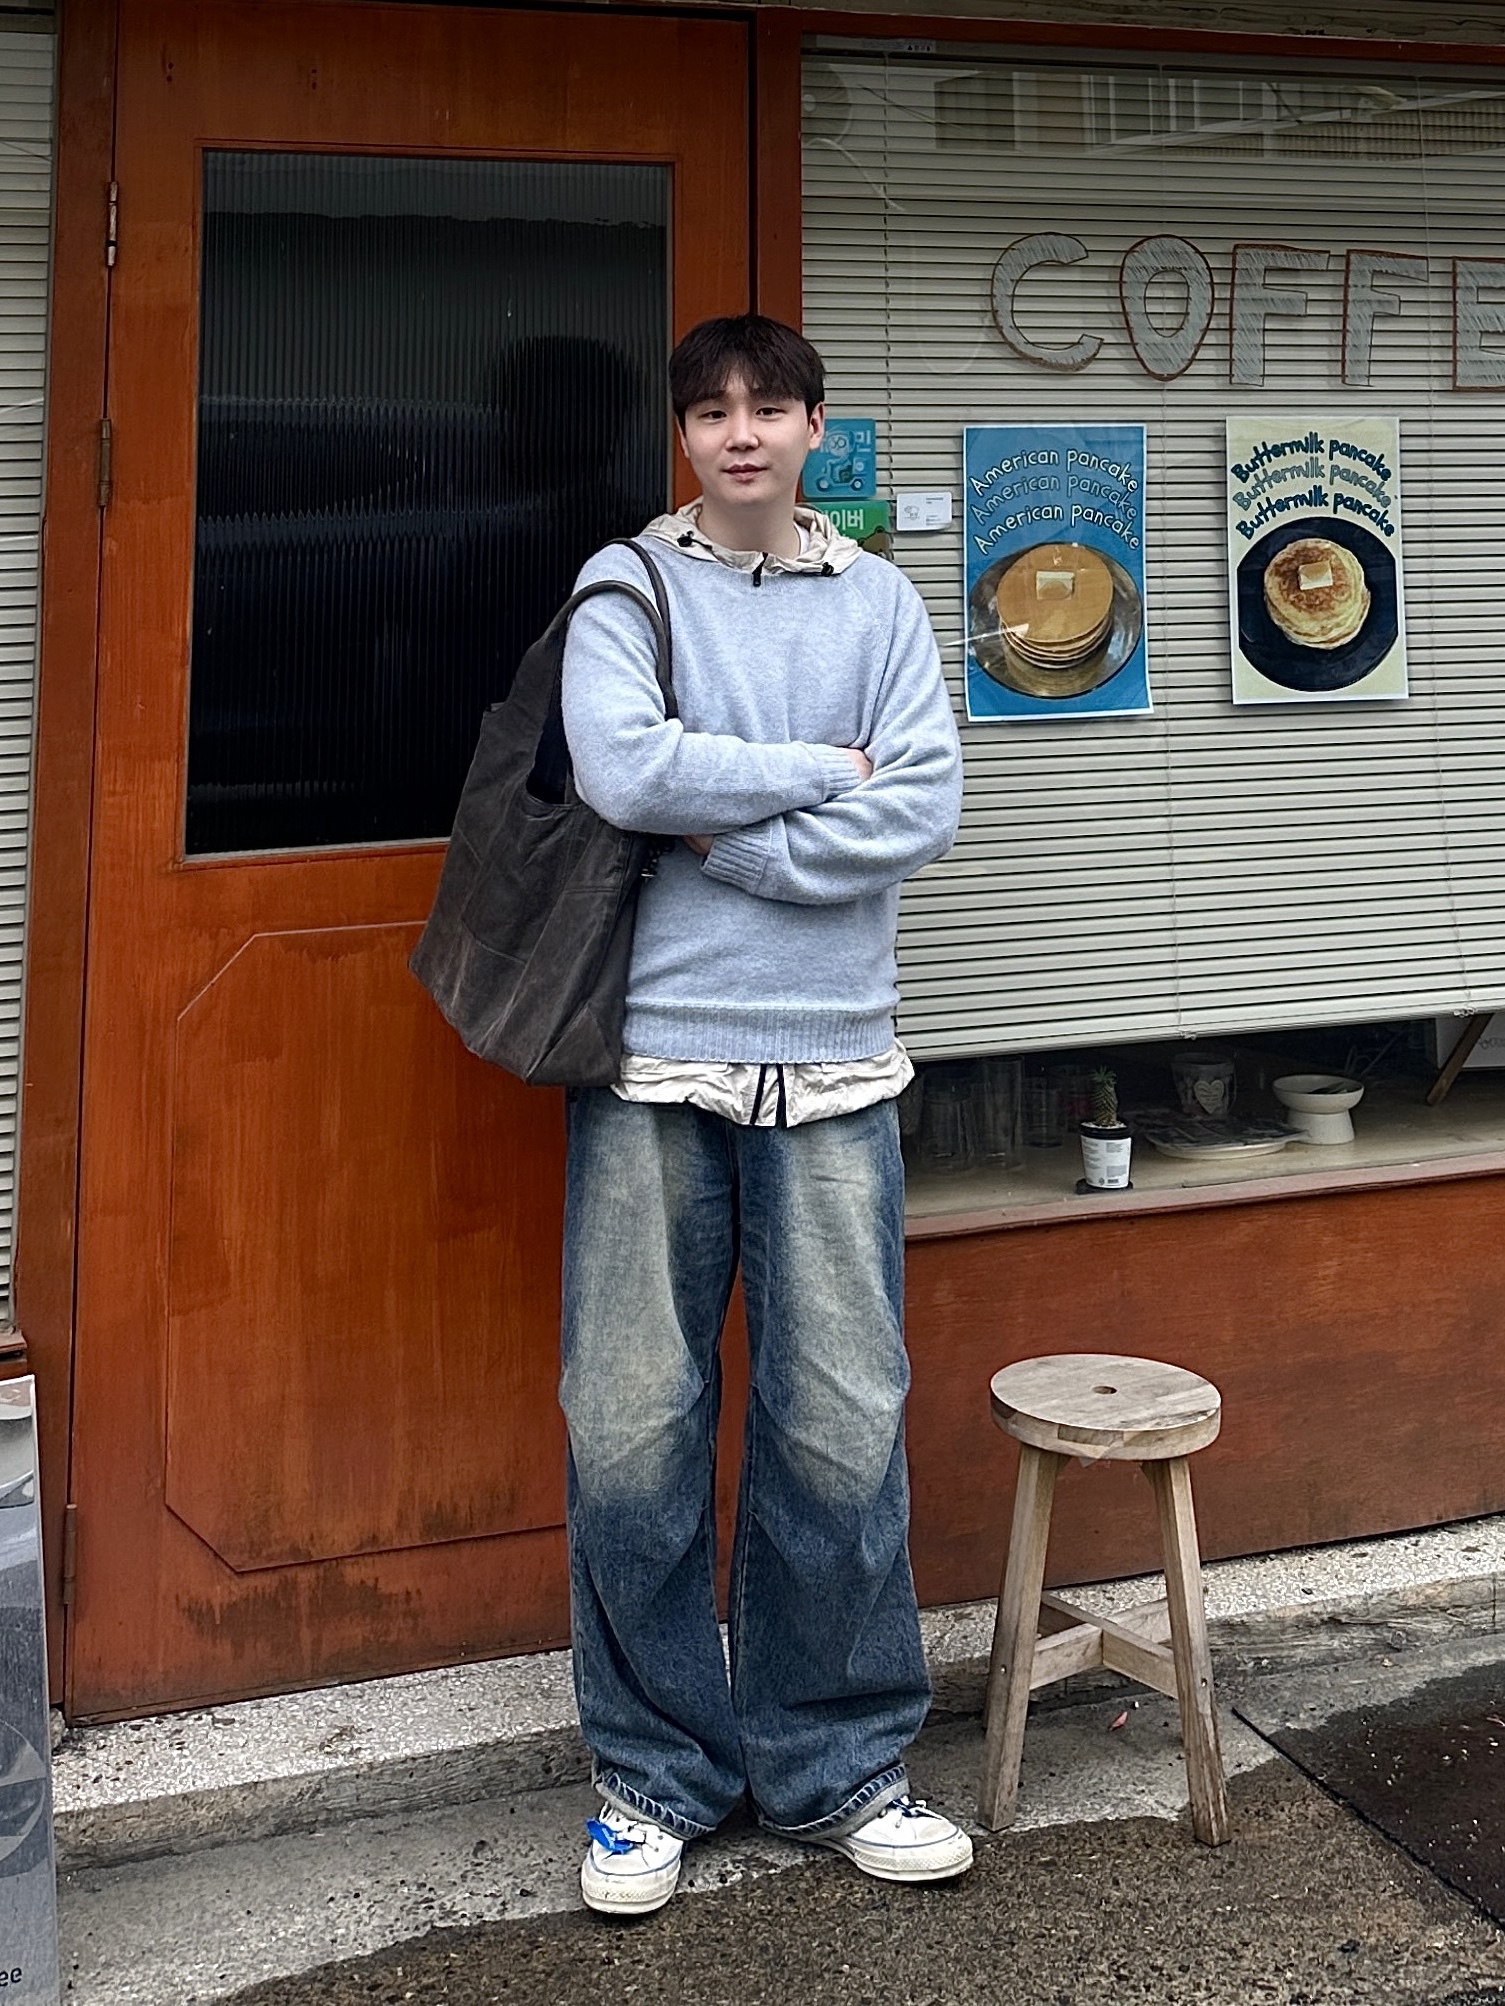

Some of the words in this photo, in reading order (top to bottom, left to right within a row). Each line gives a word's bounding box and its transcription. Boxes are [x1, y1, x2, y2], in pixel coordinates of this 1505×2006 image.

[991, 231, 1505, 392] COFFE
[970, 450, 1059, 497] American
[1066, 448, 1139, 493] pancake
[1231, 431, 1325, 483] Buttermilk
[1329, 439, 1392, 481] pancake
[970, 475, 1060, 525] American
[1066, 474, 1138, 520] pancake
[1232, 456, 1326, 511] Buttermilk
[1329, 464, 1392, 508] pancake
[822, 509, 864, 531] 이버
[973, 504, 1063, 555] American
[1070, 503, 1140, 550] pancake
[1236, 484, 1329, 540] Buttermilk
[1333, 492, 1395, 537] pancake
